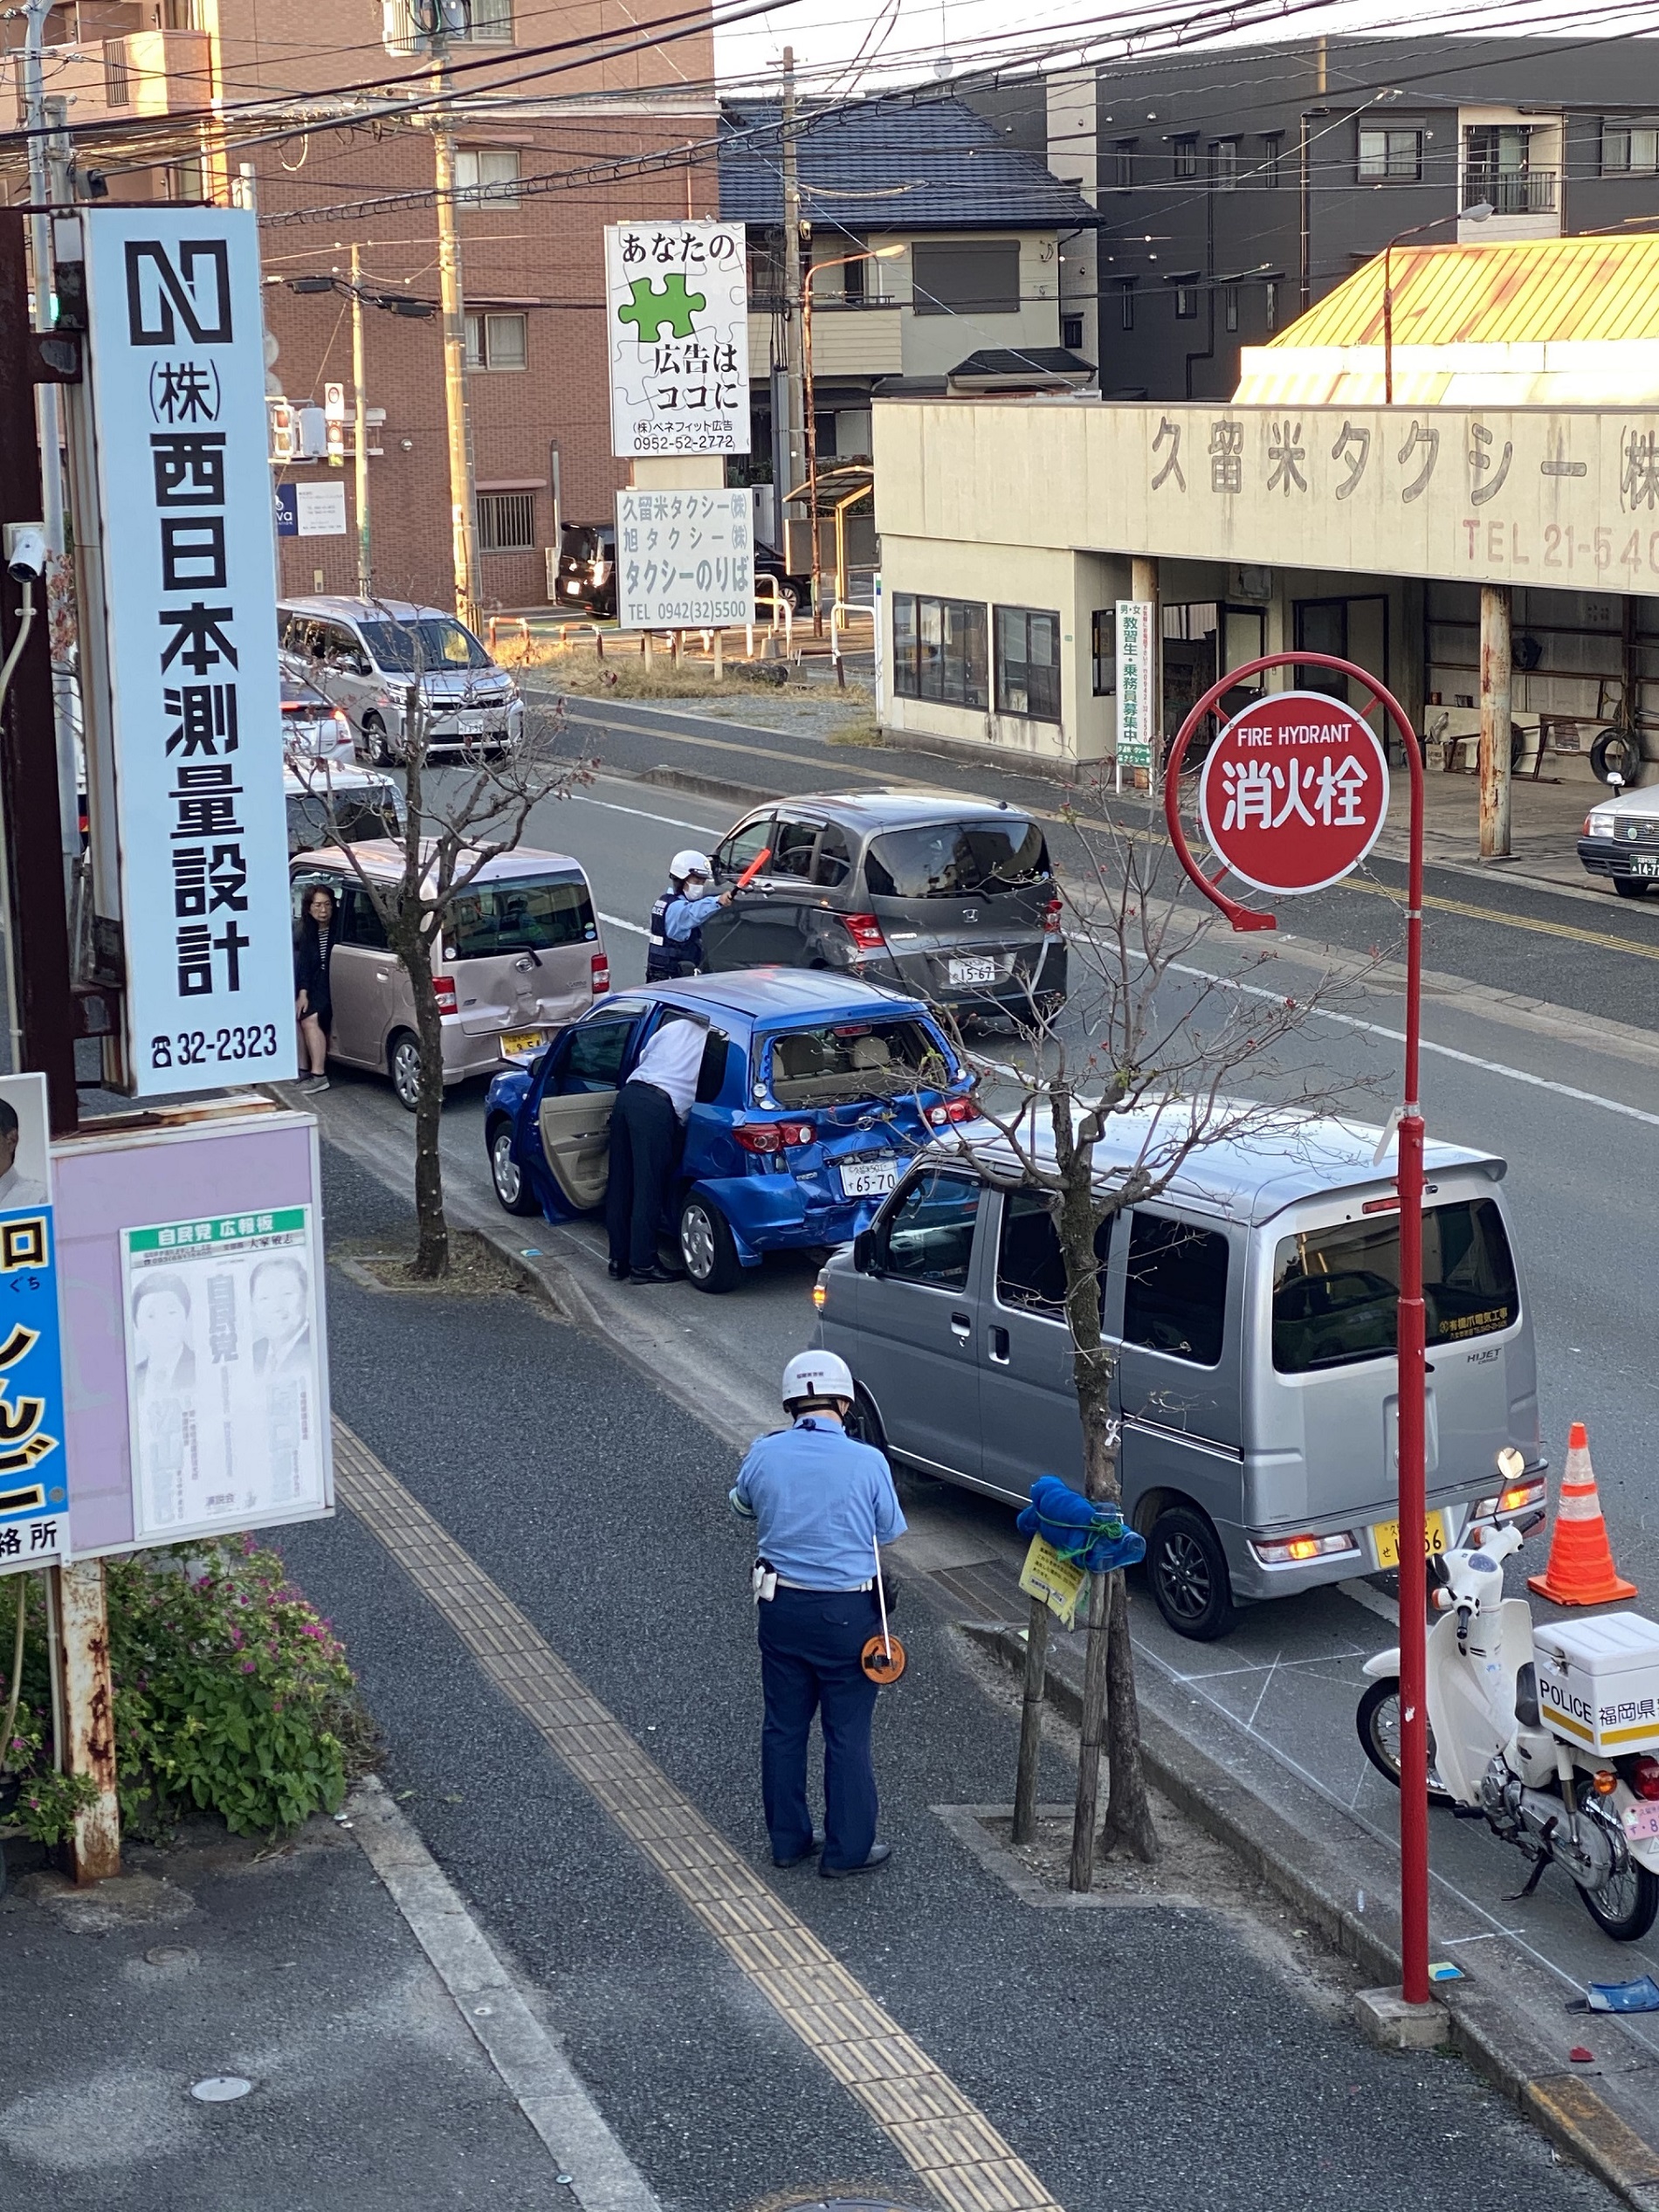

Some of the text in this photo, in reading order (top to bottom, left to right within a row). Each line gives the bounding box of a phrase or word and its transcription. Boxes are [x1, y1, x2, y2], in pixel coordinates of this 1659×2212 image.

[623, 232, 735, 264] あなたの
[655, 344, 738, 375] 広告は
[657, 382, 739, 410] ココに
[634, 436, 733, 451] 0952-52-2772
[1463, 520, 1530, 565] TEL
[626, 556, 749, 596] タクシーのりば
[629, 600, 746, 623] TEL 0942(32)5500
[1123, 617, 1139, 742] 教習生・乗務員募集中
[1237, 724, 1353, 748] FIRE HYDRANT
[1222, 755, 1368, 830] 消火栓
[178, 1024, 277, 1065] 32-2323
[857, 1174, 896, 1193] 65-70
[158, 1223, 213, 1247] 自民党
[1467, 1347, 1502, 1363] HIJET
[1539, 1678, 1594, 1726] POLICE
[1599, 1698, 1659, 1726] 福岡県
